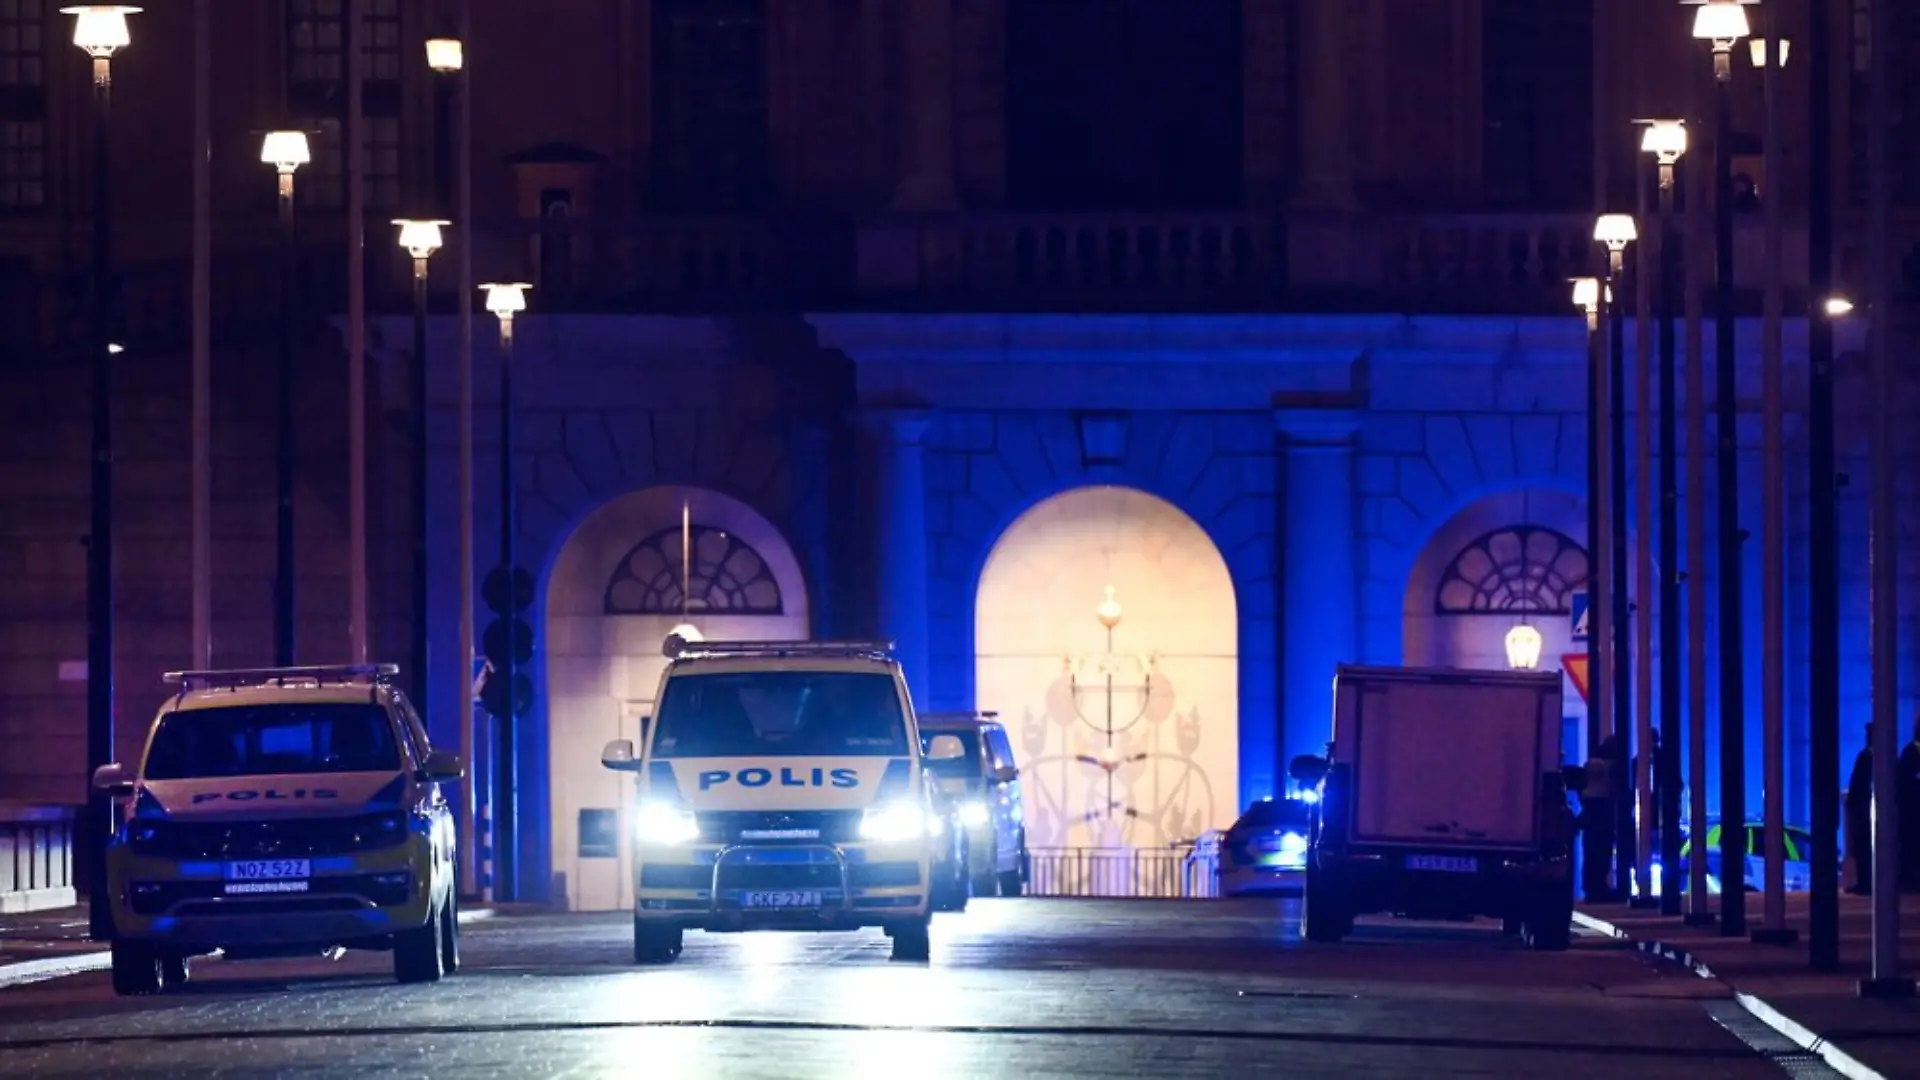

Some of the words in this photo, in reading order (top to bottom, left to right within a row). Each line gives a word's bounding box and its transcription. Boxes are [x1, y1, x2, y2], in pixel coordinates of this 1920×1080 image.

[698, 767, 859, 791] POLIS
[192, 788, 338, 804] POLIS
[236, 861, 267, 877] NOZ
